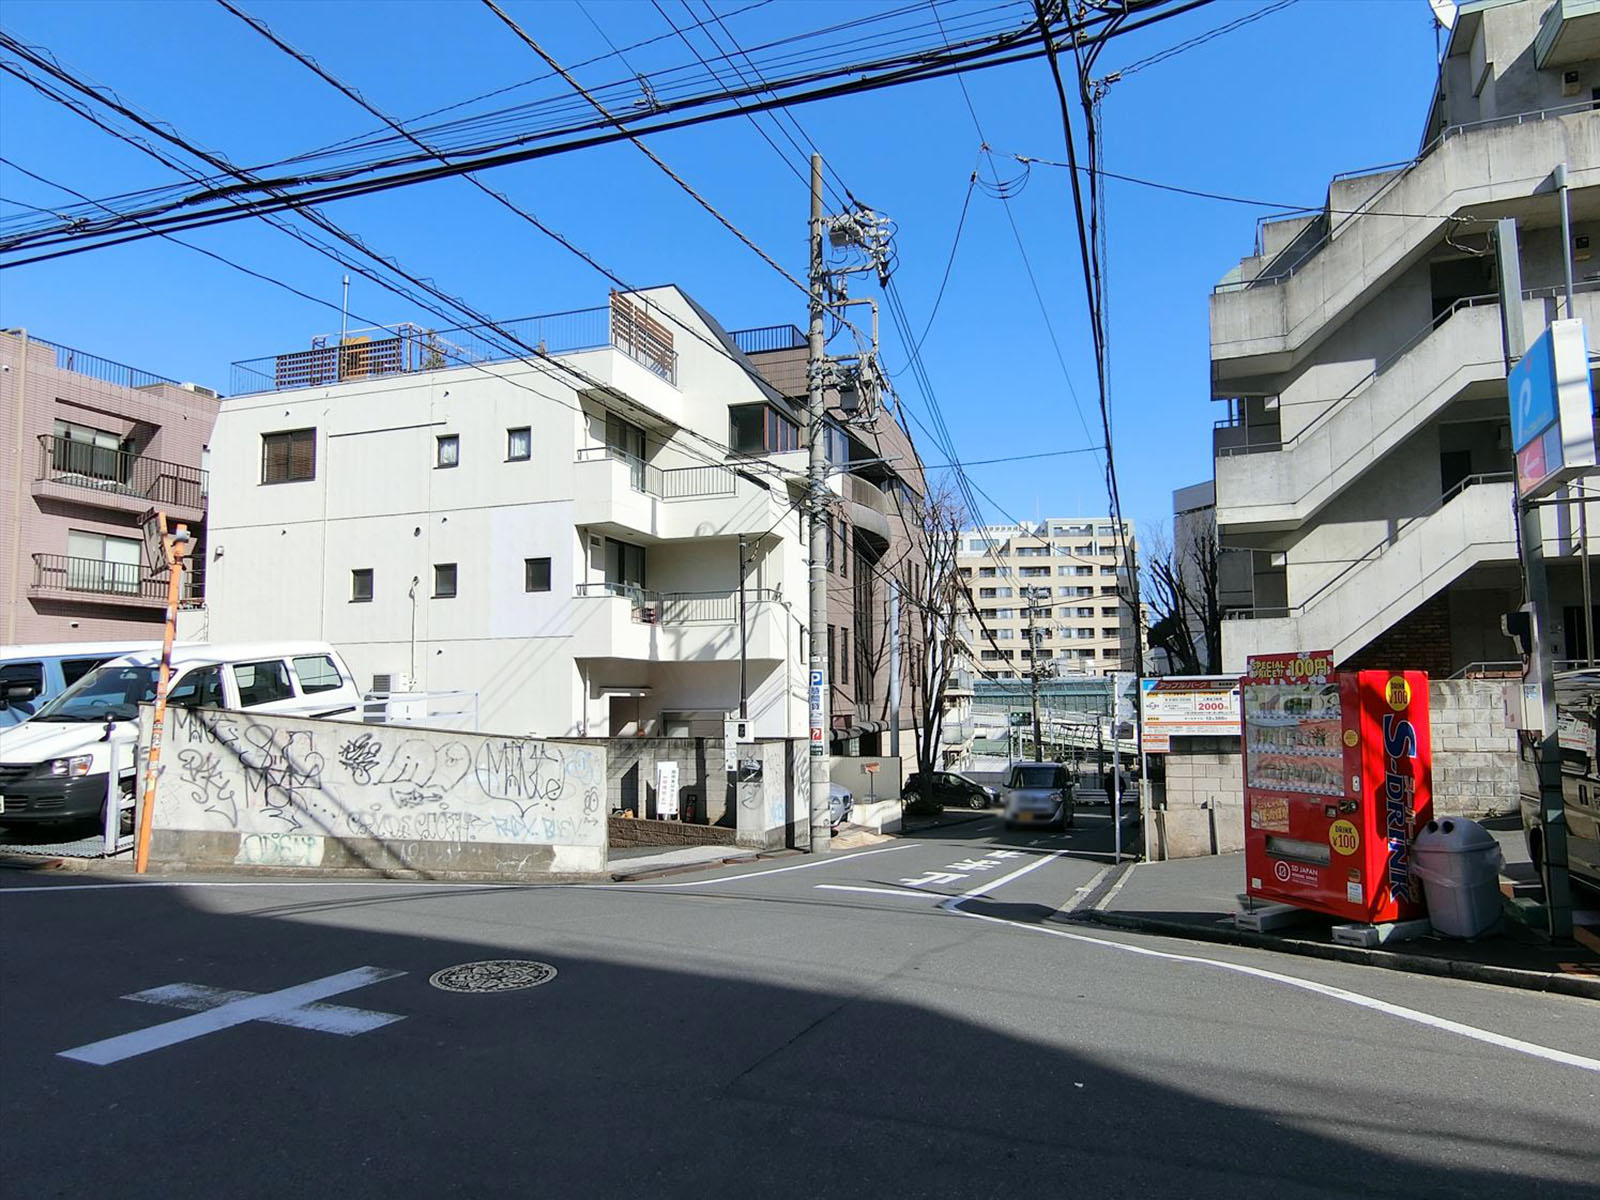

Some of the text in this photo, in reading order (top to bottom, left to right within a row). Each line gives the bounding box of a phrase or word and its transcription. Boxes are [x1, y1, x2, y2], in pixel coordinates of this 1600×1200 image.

[1252, 660, 1285, 670] SPECIAL
[1288, 658, 1327, 677] 100円
[1382, 713, 1417, 904] S-DRINK
[1335, 826, 1353, 834] DRINK
[1333, 834, 1355, 848] ¥100
